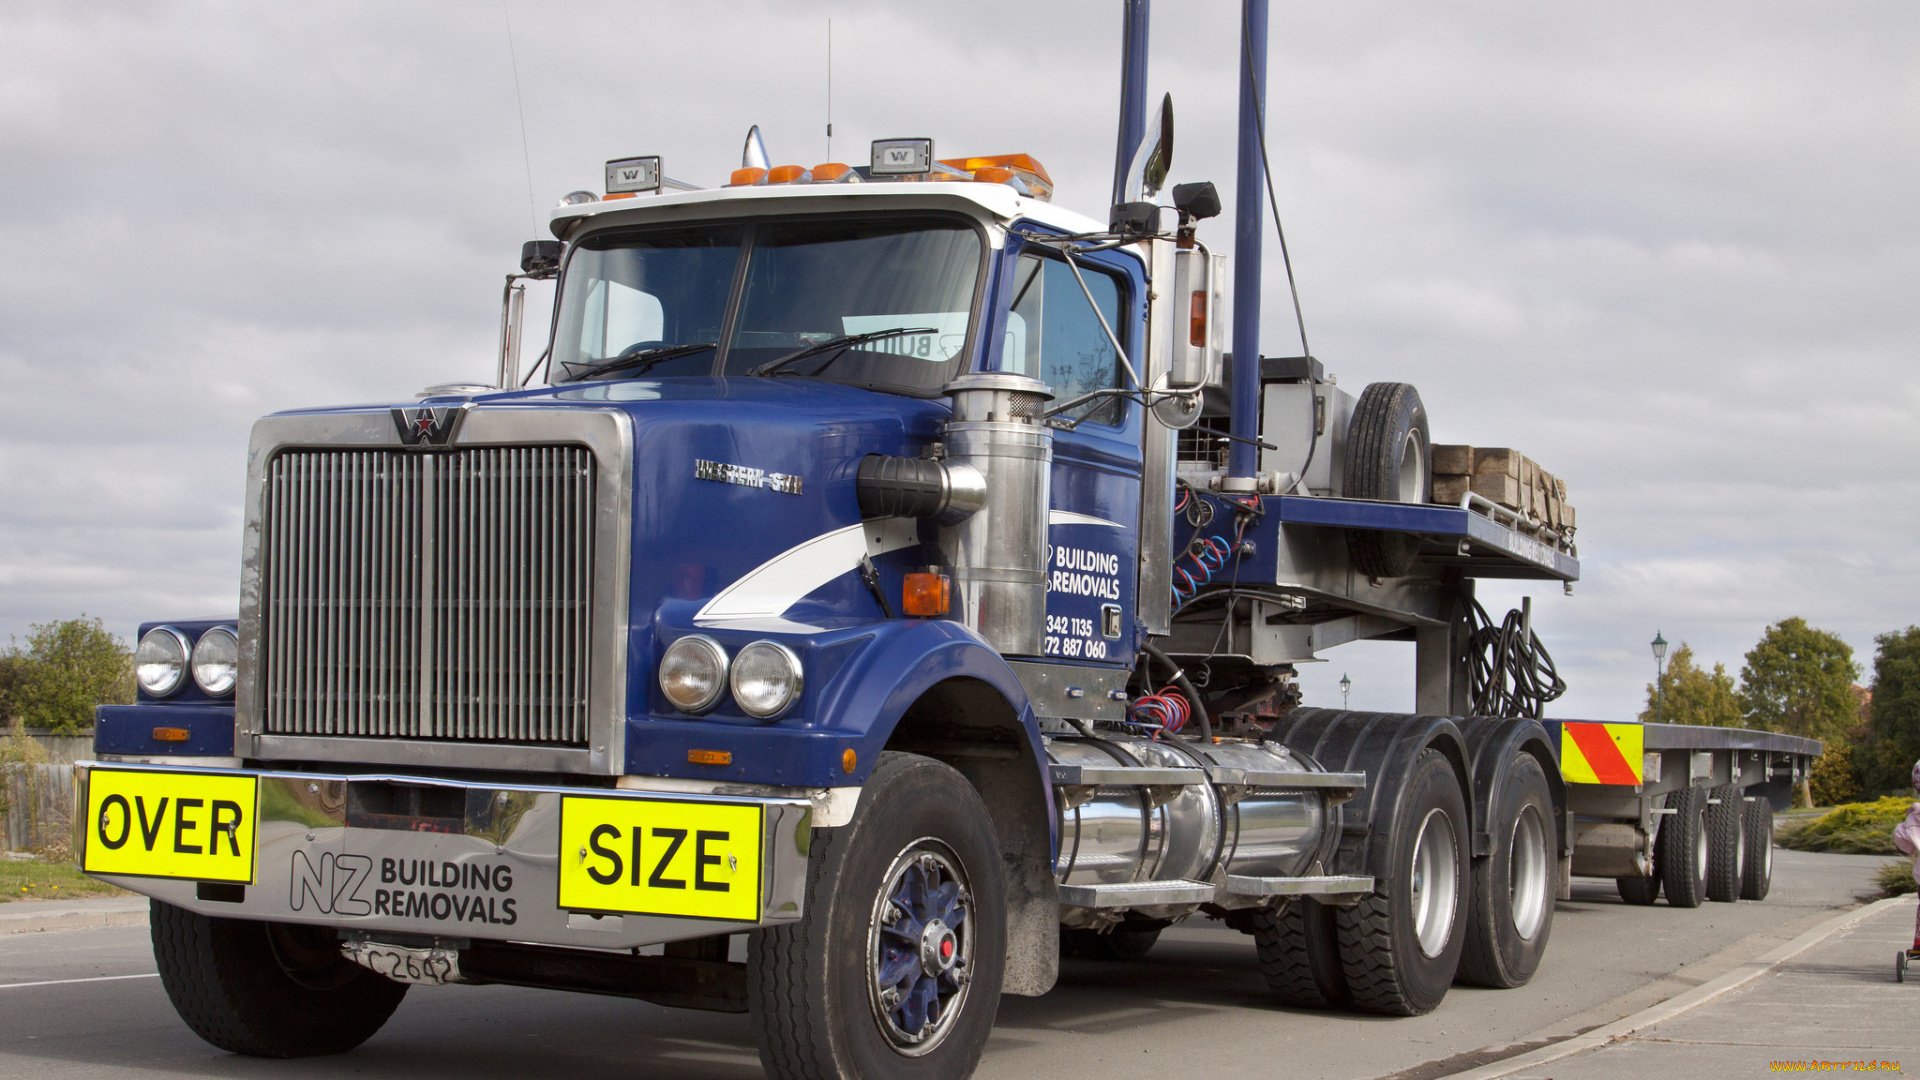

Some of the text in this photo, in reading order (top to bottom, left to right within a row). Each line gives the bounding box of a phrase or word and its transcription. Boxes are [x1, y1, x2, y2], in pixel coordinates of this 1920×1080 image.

[891, 151, 908, 162] W
[623, 169, 639, 180] W
[695, 458, 803, 495] WESTERN STAR
[1056, 546, 1118, 576] BUILDING
[1053, 570, 1120, 600] REMOVALS
[1046, 614, 1093, 637] 342 1135
[1045, 636, 1106, 659] 72 887 060
[98, 793, 243, 857] OVER
[586, 823, 731, 893] SIZE
[290, 850, 514, 916] NZ BUILDING
[375, 888, 518, 926] REMOVALS
